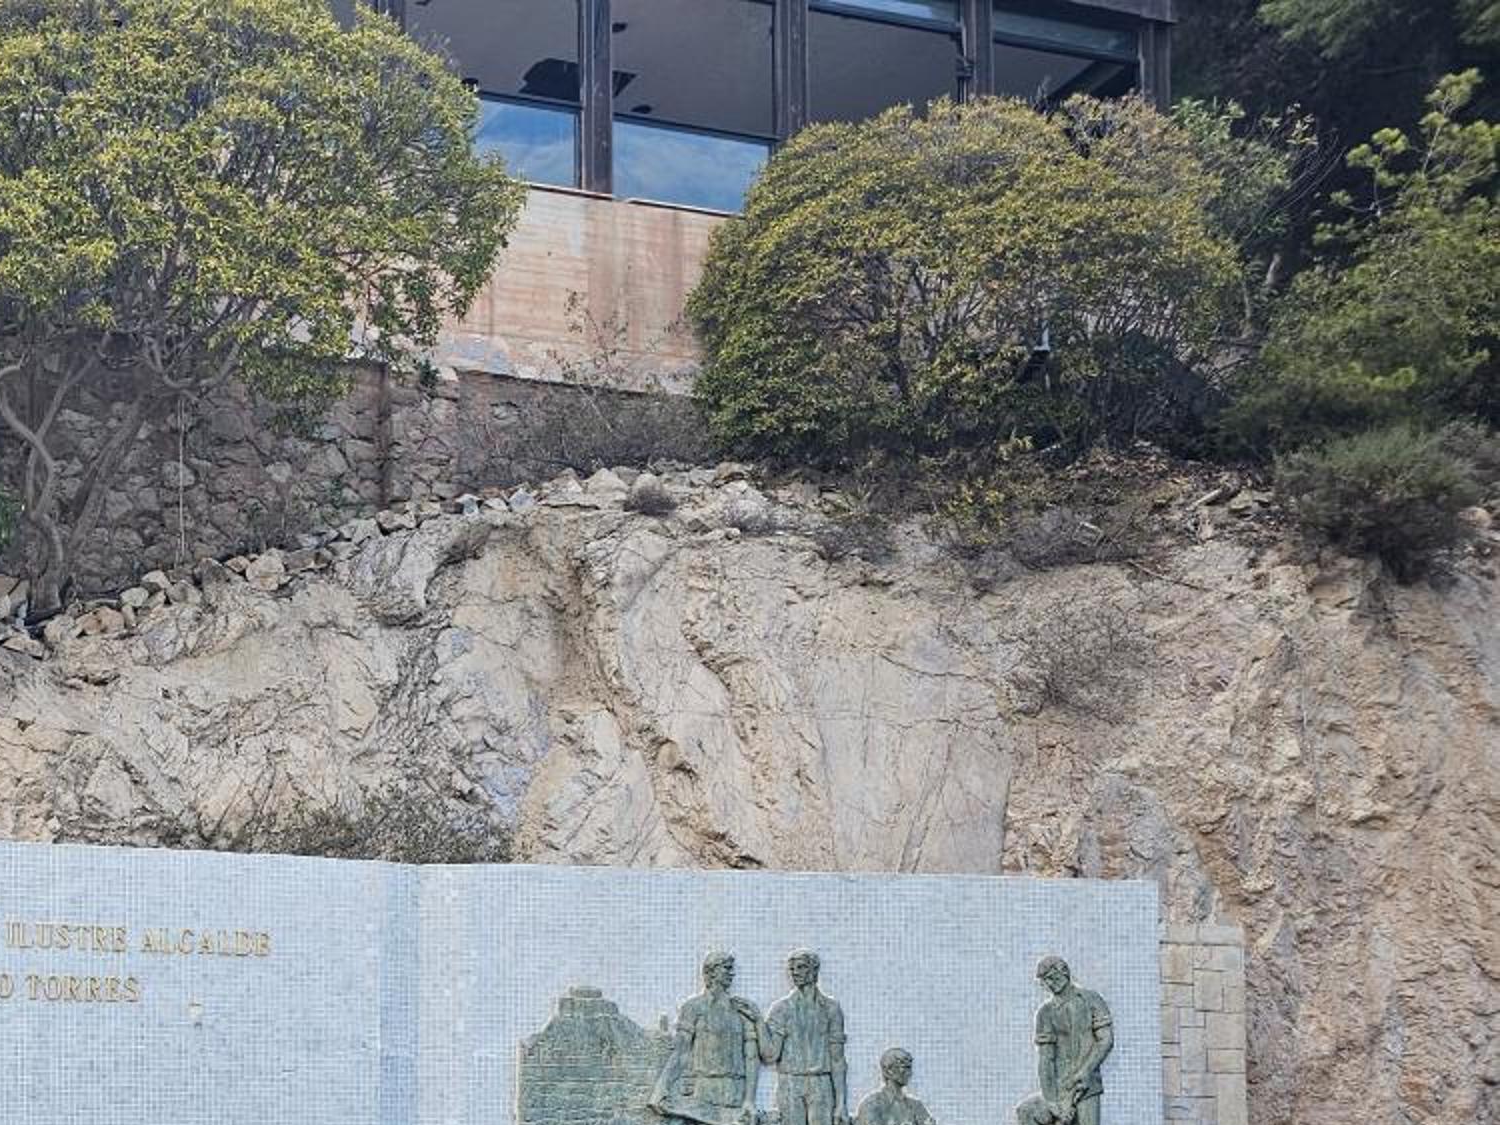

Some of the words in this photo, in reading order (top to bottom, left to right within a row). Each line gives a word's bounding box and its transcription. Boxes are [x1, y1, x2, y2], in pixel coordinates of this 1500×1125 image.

[5, 920, 128, 952] ILUSTRE
[139, 928, 273, 957] ALCALDE
[25, 974, 141, 1003] TORRES
